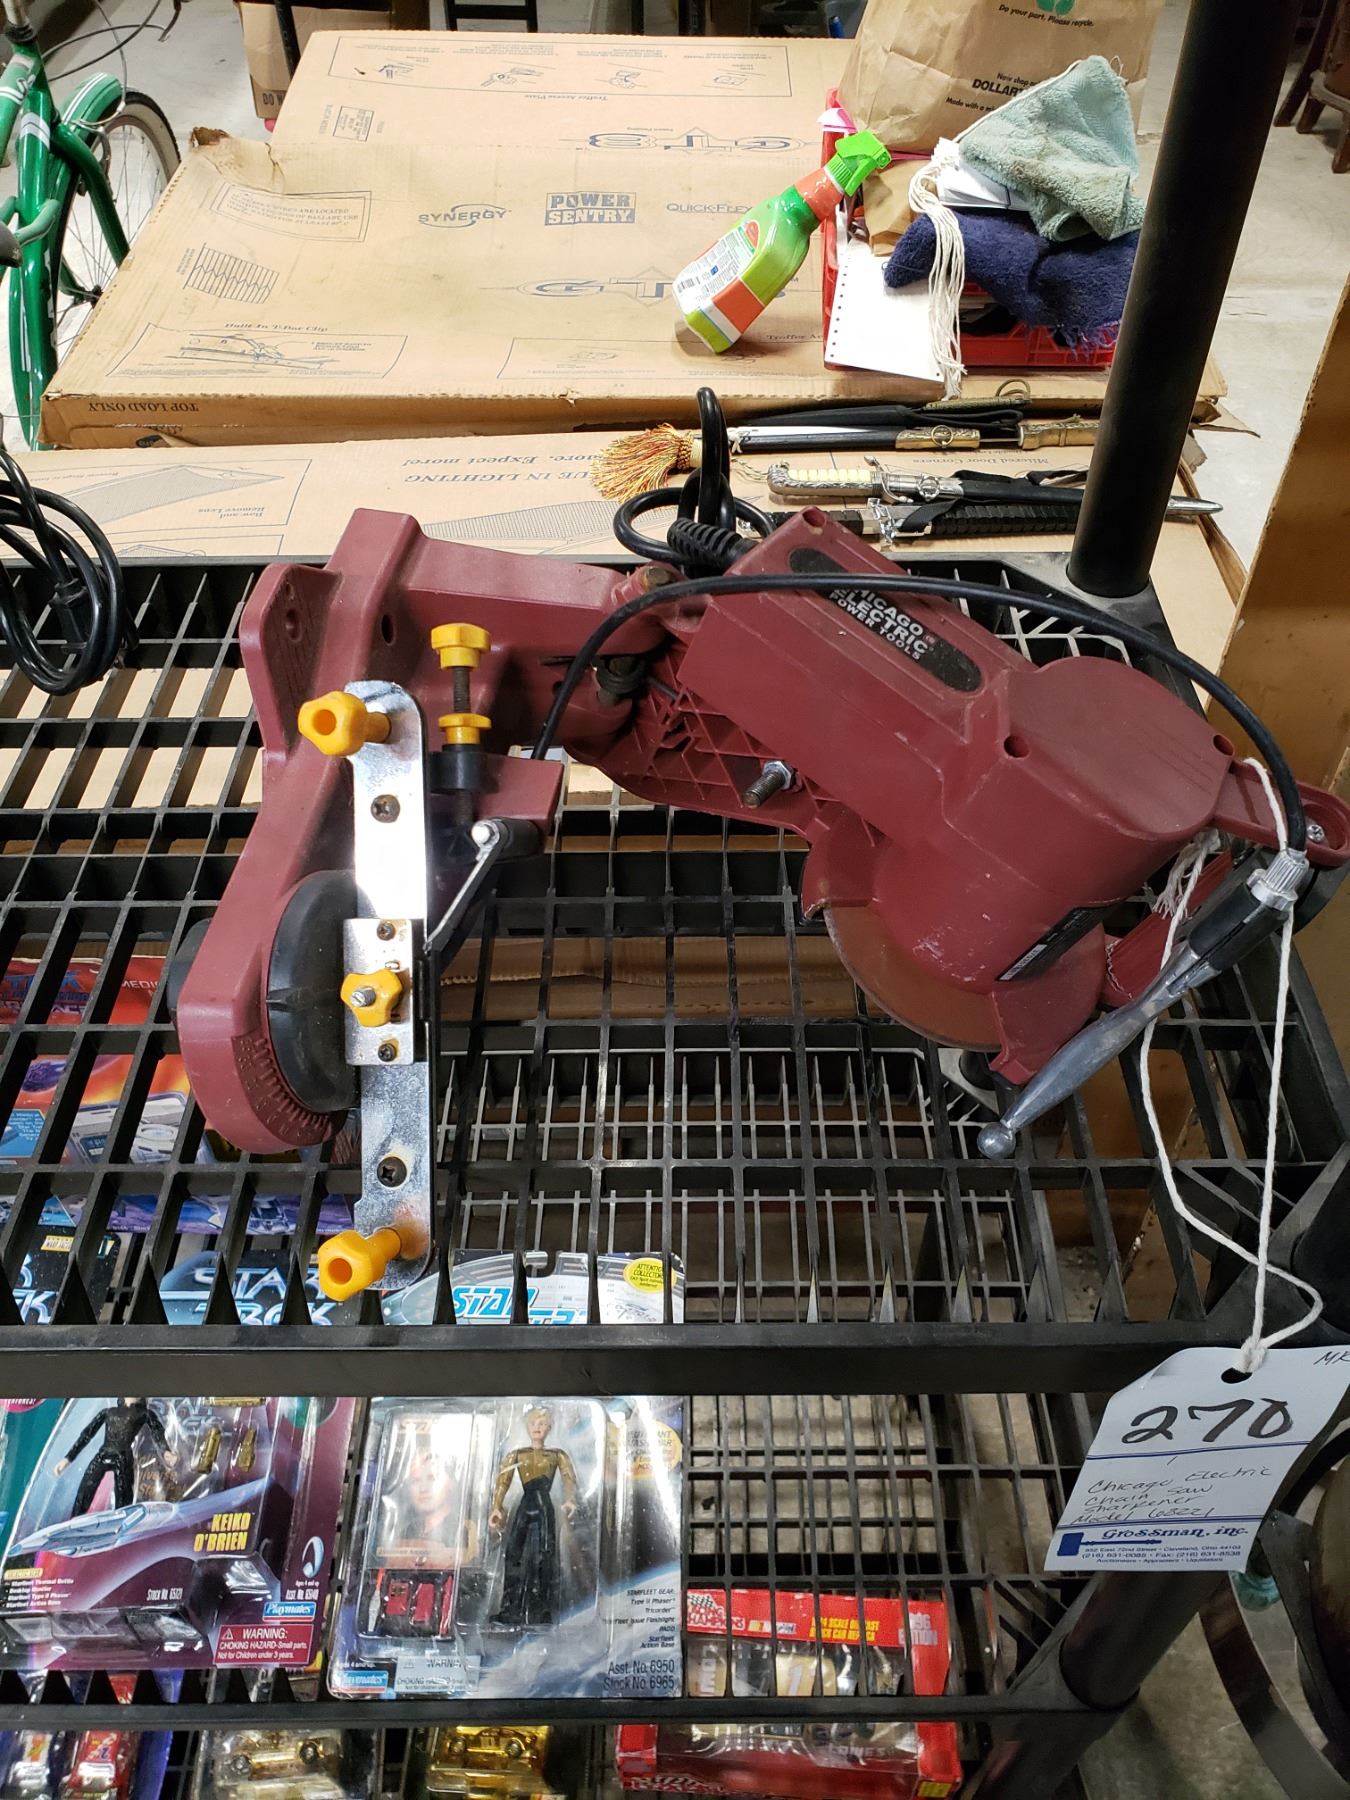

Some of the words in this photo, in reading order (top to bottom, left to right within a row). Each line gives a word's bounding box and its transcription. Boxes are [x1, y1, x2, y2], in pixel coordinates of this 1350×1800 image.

[1010, 7, 1028, 17] your
[1047, 15, 1070, 26] Please
[550, 193, 631, 208] POWER
[418, 208, 507, 225] SYNERGY
[548, 208, 634, 225] SENTRY
[88, 402, 126, 412] ONLY
[128, 402, 168, 412] LOAD
[170, 402, 200, 412] TOP
[402, 457, 461, 467] more!
[467, 455, 539, 465] Expect
[405, 473, 521, 483] LIGHTING
[526, 472, 551, 481] IN
[858, 589, 924, 637] HICAGO
[829, 592, 876, 628] POWER
[879, 627, 922, 661] TOOLS
[1121, 1397, 1294, 1444] 270
[1087, 1479, 1173, 1497] Chicago
[1184, 1465, 1274, 1483] Electric
[211, 1512, 252, 1532] KEIKO
[1101, 1527, 1211, 1540] Grossman,
[1213, 1525, 1250, 1537] inc.
[193, 1531, 249, 1552] O'BRIEN
[265, 1602, 312, 1615] Playmates
[242, 1627, 289, 1639] WARNING:
[219, 1640, 249, 1650] CHOKING
[293, 1642, 308, 1650] parts.
[217, 1651, 228, 1659] Not
[235, 1651, 258, 1659] Children
[257, 1651, 273, 1659] under
[649, 1658, 676, 1674] 6950
[649, 1674, 675, 1690] 6965
